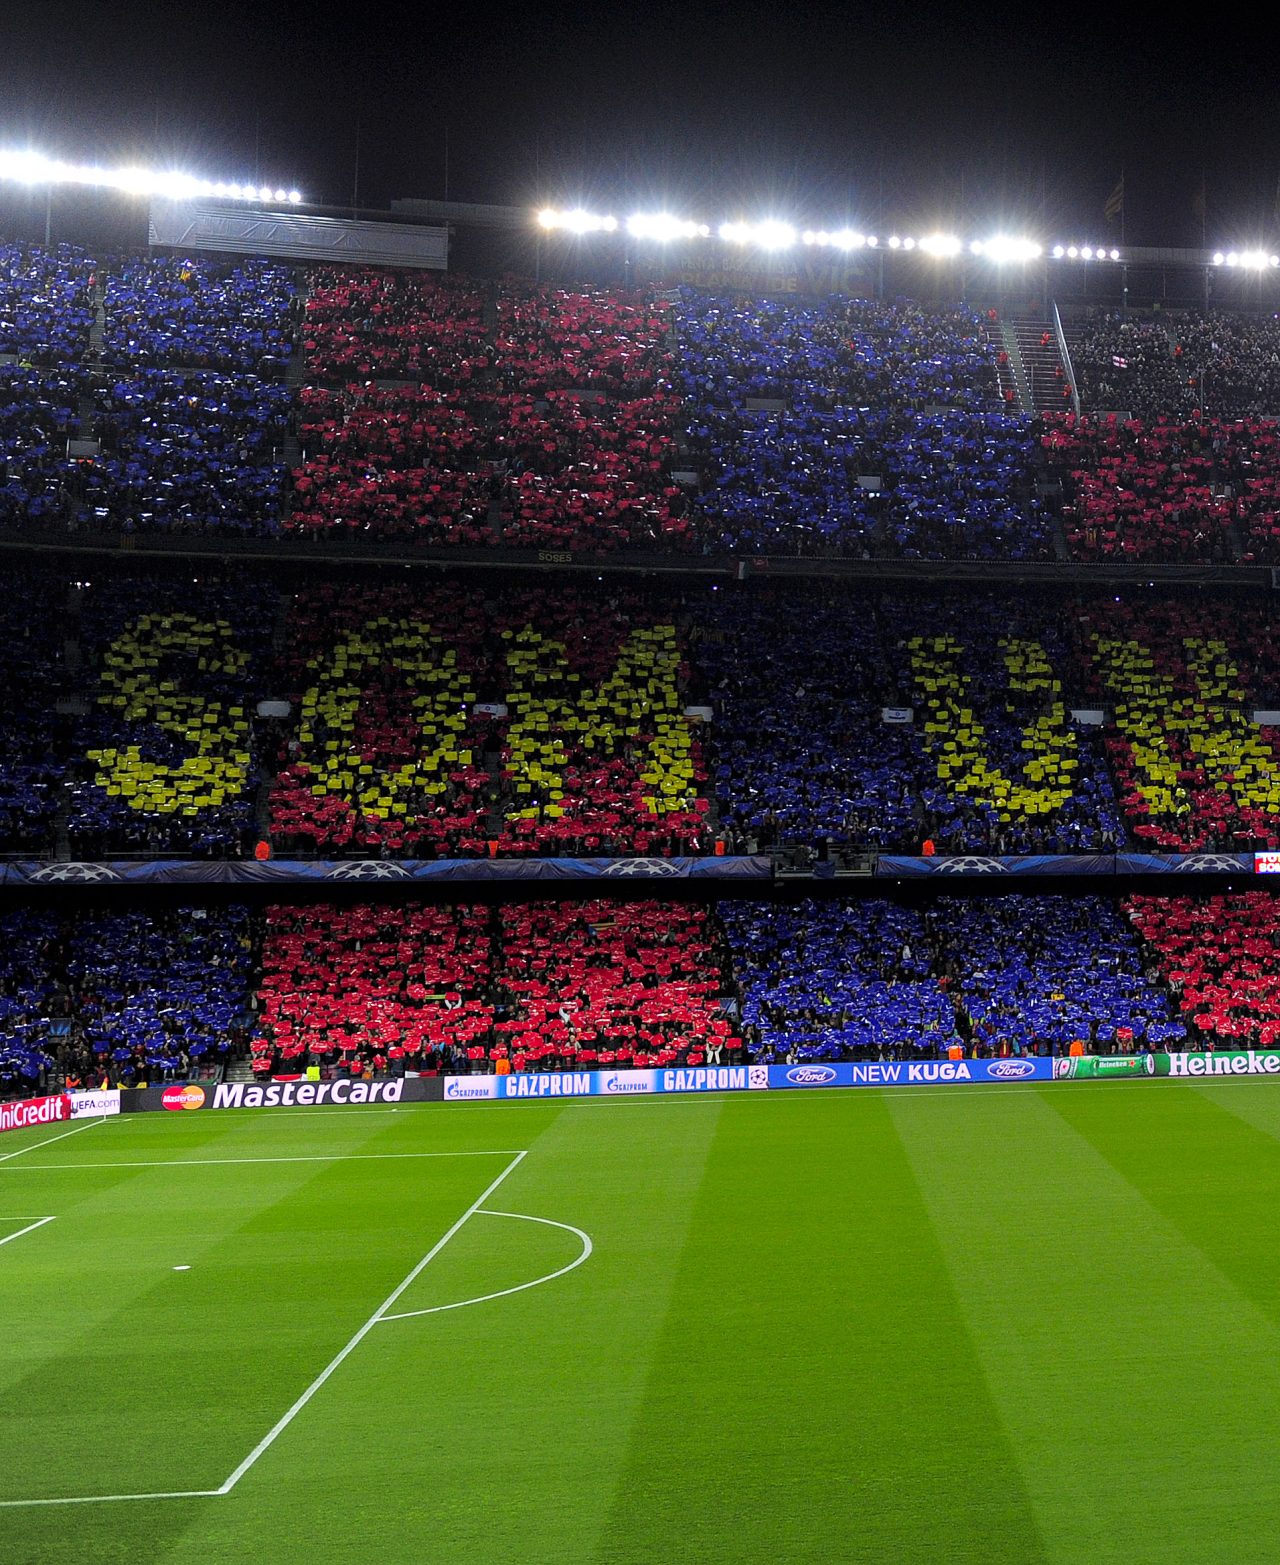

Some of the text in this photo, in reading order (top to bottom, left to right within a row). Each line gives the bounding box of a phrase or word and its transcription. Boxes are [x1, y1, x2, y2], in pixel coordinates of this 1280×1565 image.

[772, 277, 797, 292] DE
[805, 262, 864, 297] VIC
[537, 552, 572, 562] SOSES
[795, 1067, 827, 1082] Ford
[853, 1063, 972, 1082] NEW KUGA
[995, 1062, 1026, 1077] Ford
[506, 1073, 591, 1096] GAZPROM
[664, 1068, 745, 1091] GAZPROM
[213, 1078, 404, 1109] MasterCard
[459, 1088, 489, 1097] GAZPROM
[618, 1083, 648, 1092] GAZPROM
[72, 1097, 120, 1110] UEFA.com
[163, 1094, 204, 1103] MasterCard
